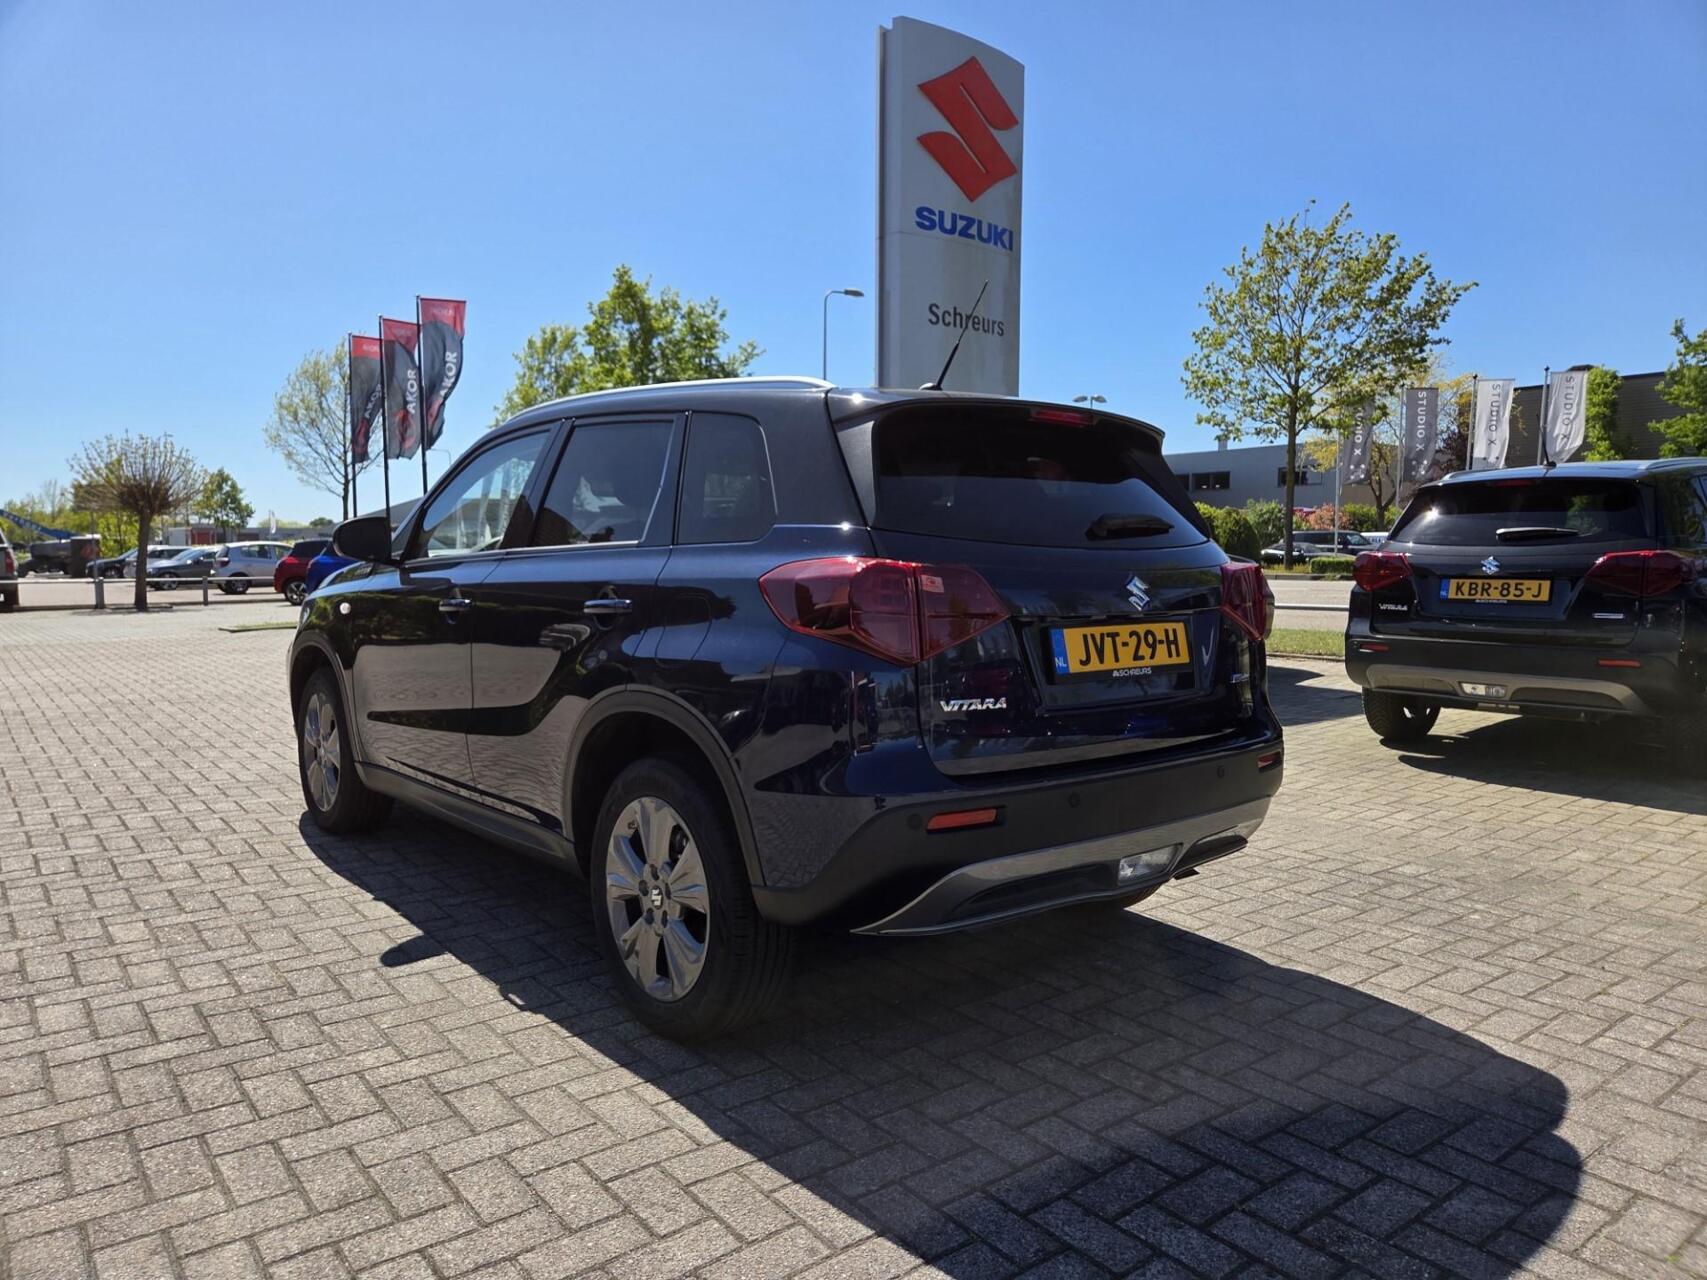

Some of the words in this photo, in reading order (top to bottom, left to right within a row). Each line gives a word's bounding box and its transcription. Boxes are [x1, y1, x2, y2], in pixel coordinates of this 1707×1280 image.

[915, 206, 1013, 252] SUZUKI
[928, 303, 1004, 337] Schreurs
[406, 369, 418, 414] AKOR
[440, 351, 458, 398] AKOR
[1416, 391, 1427, 438] STUDIO
[1489, 384, 1501, 432] STUDIO
[1561, 376, 1575, 426] STUDIO
[1353, 448, 1362, 456] X
[1415, 443, 1425, 451] X
[1561, 433, 1570, 441] X
[1455, 581, 1542, 598] KBR-85-J
[1055, 657, 1067, 667] NL
[1079, 628, 1180, 667] JVT-29-H
[940, 697, 1007, 712] VITARA
